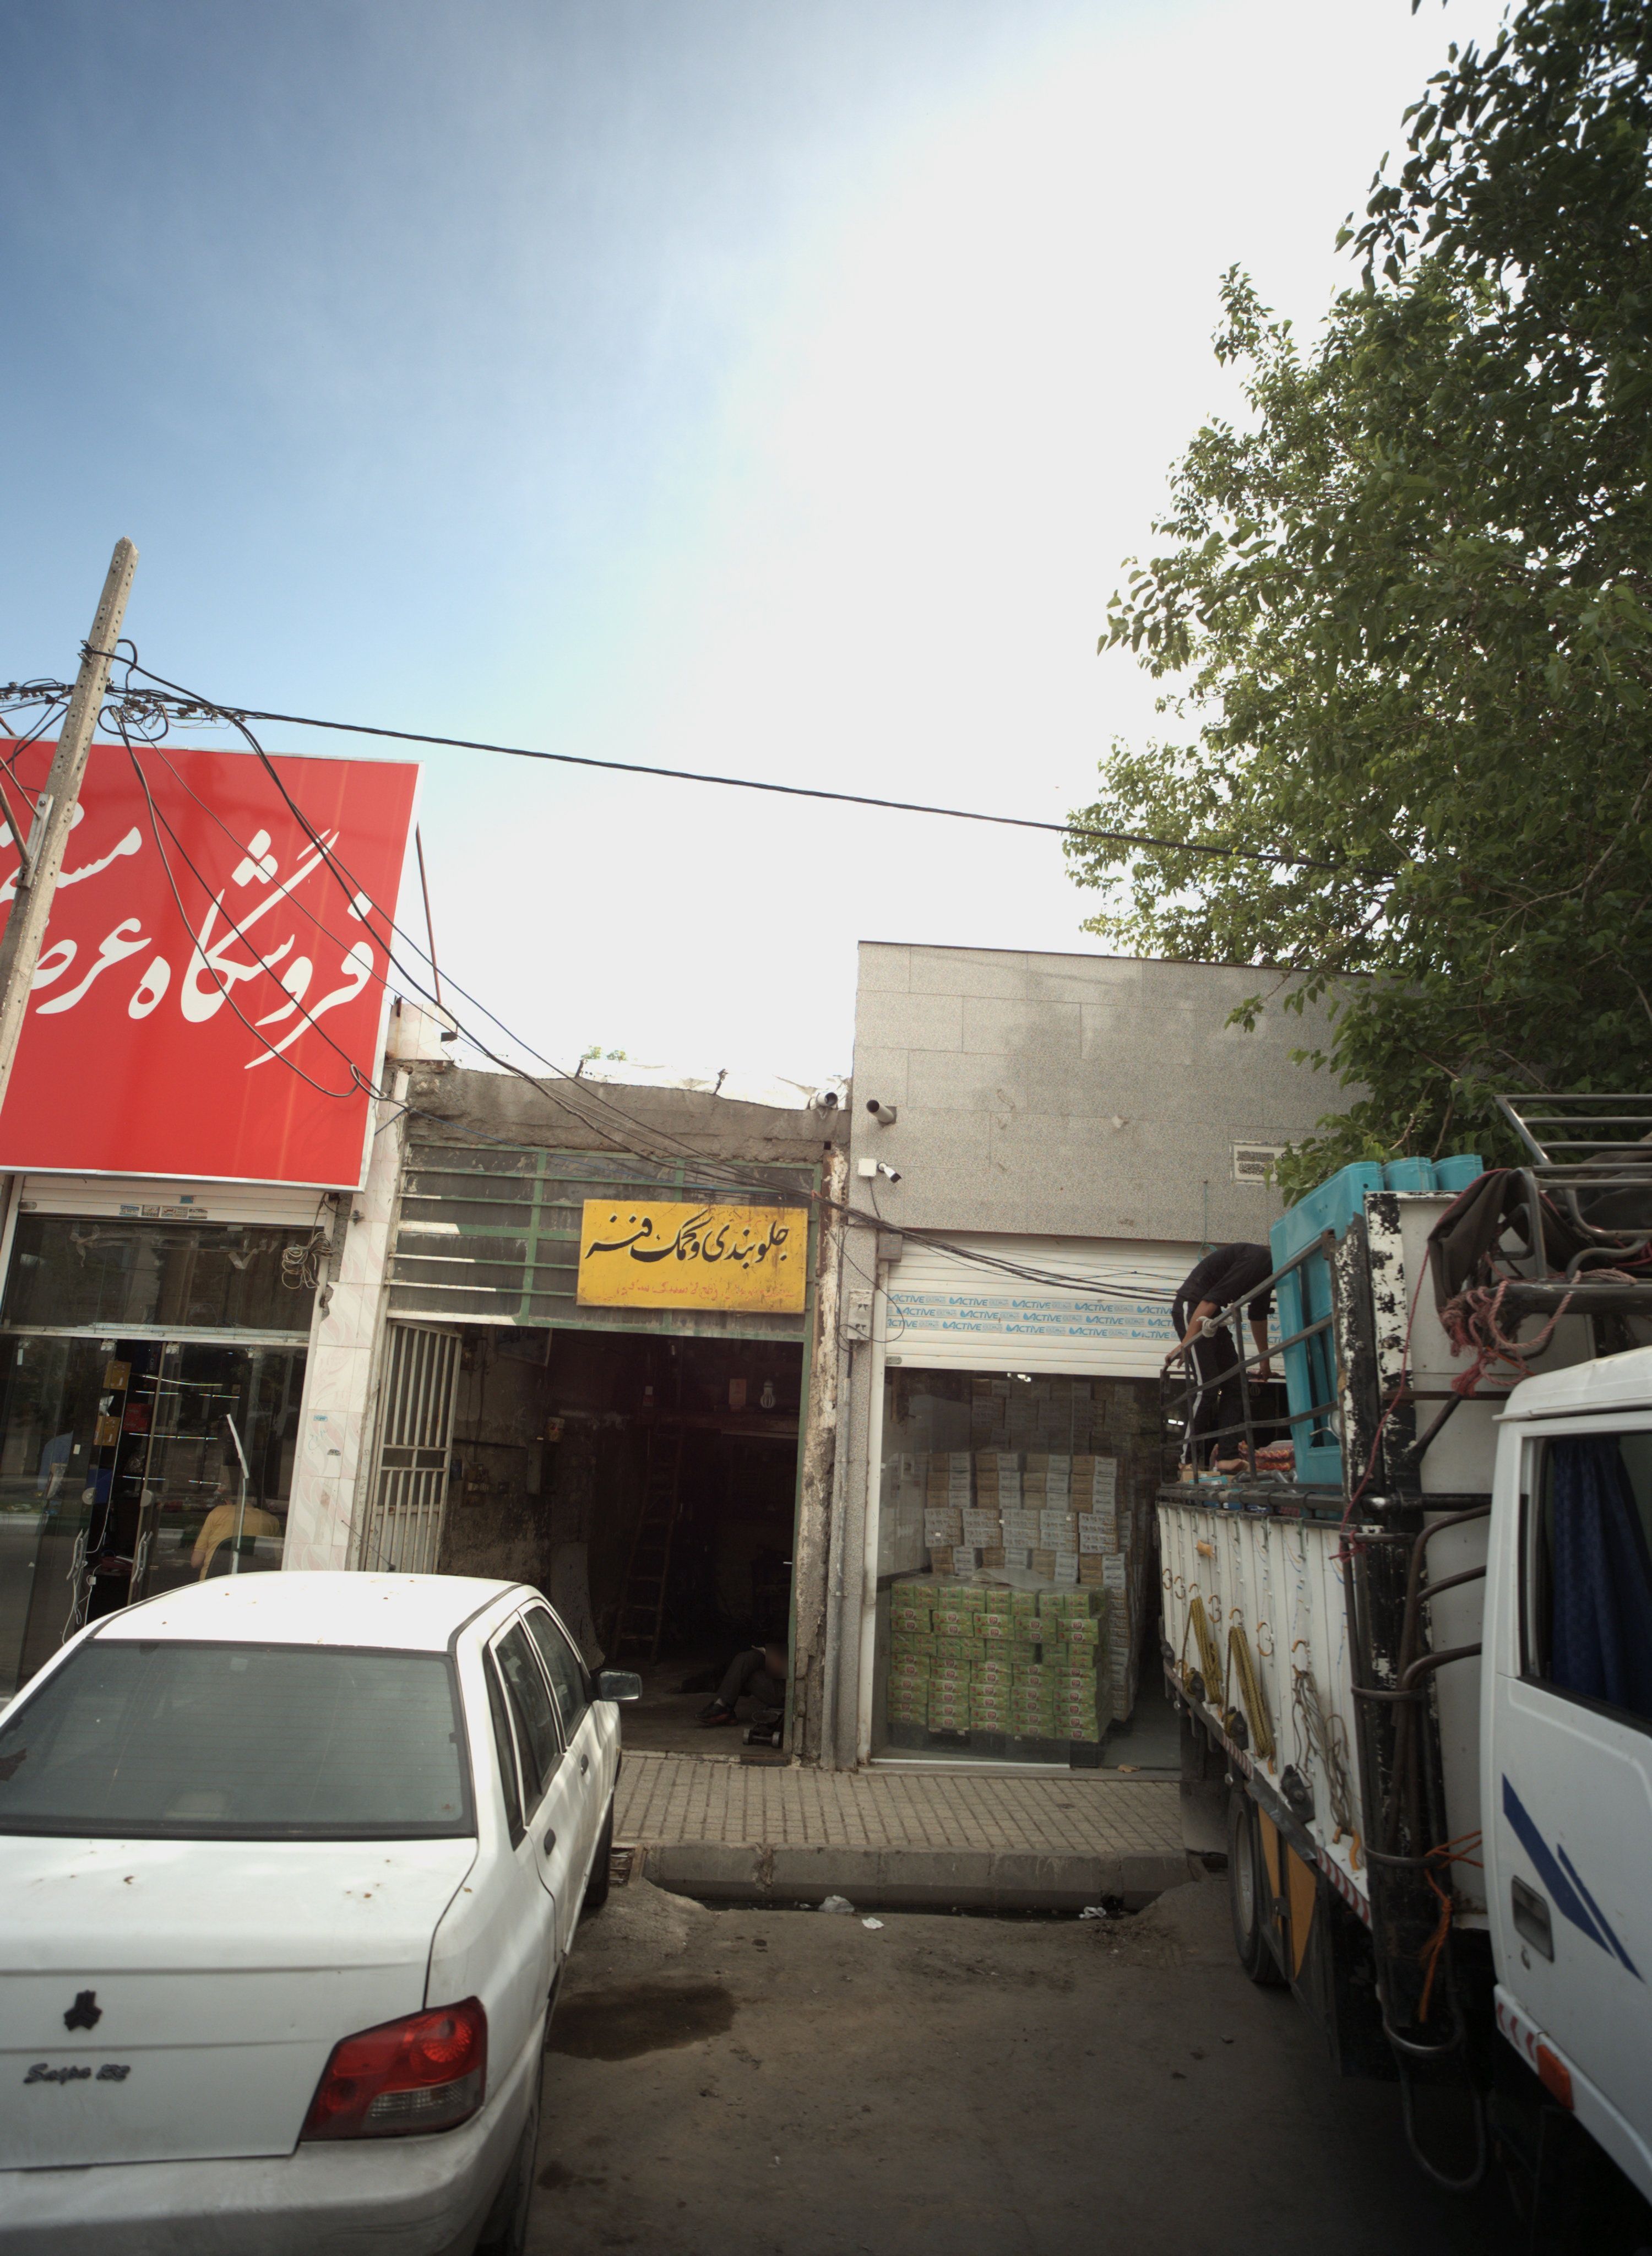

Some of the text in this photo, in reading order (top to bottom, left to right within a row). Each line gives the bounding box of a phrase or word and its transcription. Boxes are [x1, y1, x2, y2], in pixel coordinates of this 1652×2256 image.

[128, 828, 374, 1069] فروشگاه
[585, 1215, 653, 1259] فنر
[951, 1297, 988, 1306] ACTIVE
[1014, 1299, 1051, 1309] ACTIVE
[1077, 1302, 1113, 1312] ACTIVE
[901, 1307, 936, 1316] ACTIVE
[962, 1310, 999, 1319] ACTIVE
[1025, 1313, 1062, 1322] ACTIVE
[1088, 1315, 1124, 1325] ACTIVE
[944, 1321, 982, 1331] ACTIVE
[1008, 1324, 1045, 1333] ACTIVE
[1072, 1327, 1108, 1336] ACTIVE
